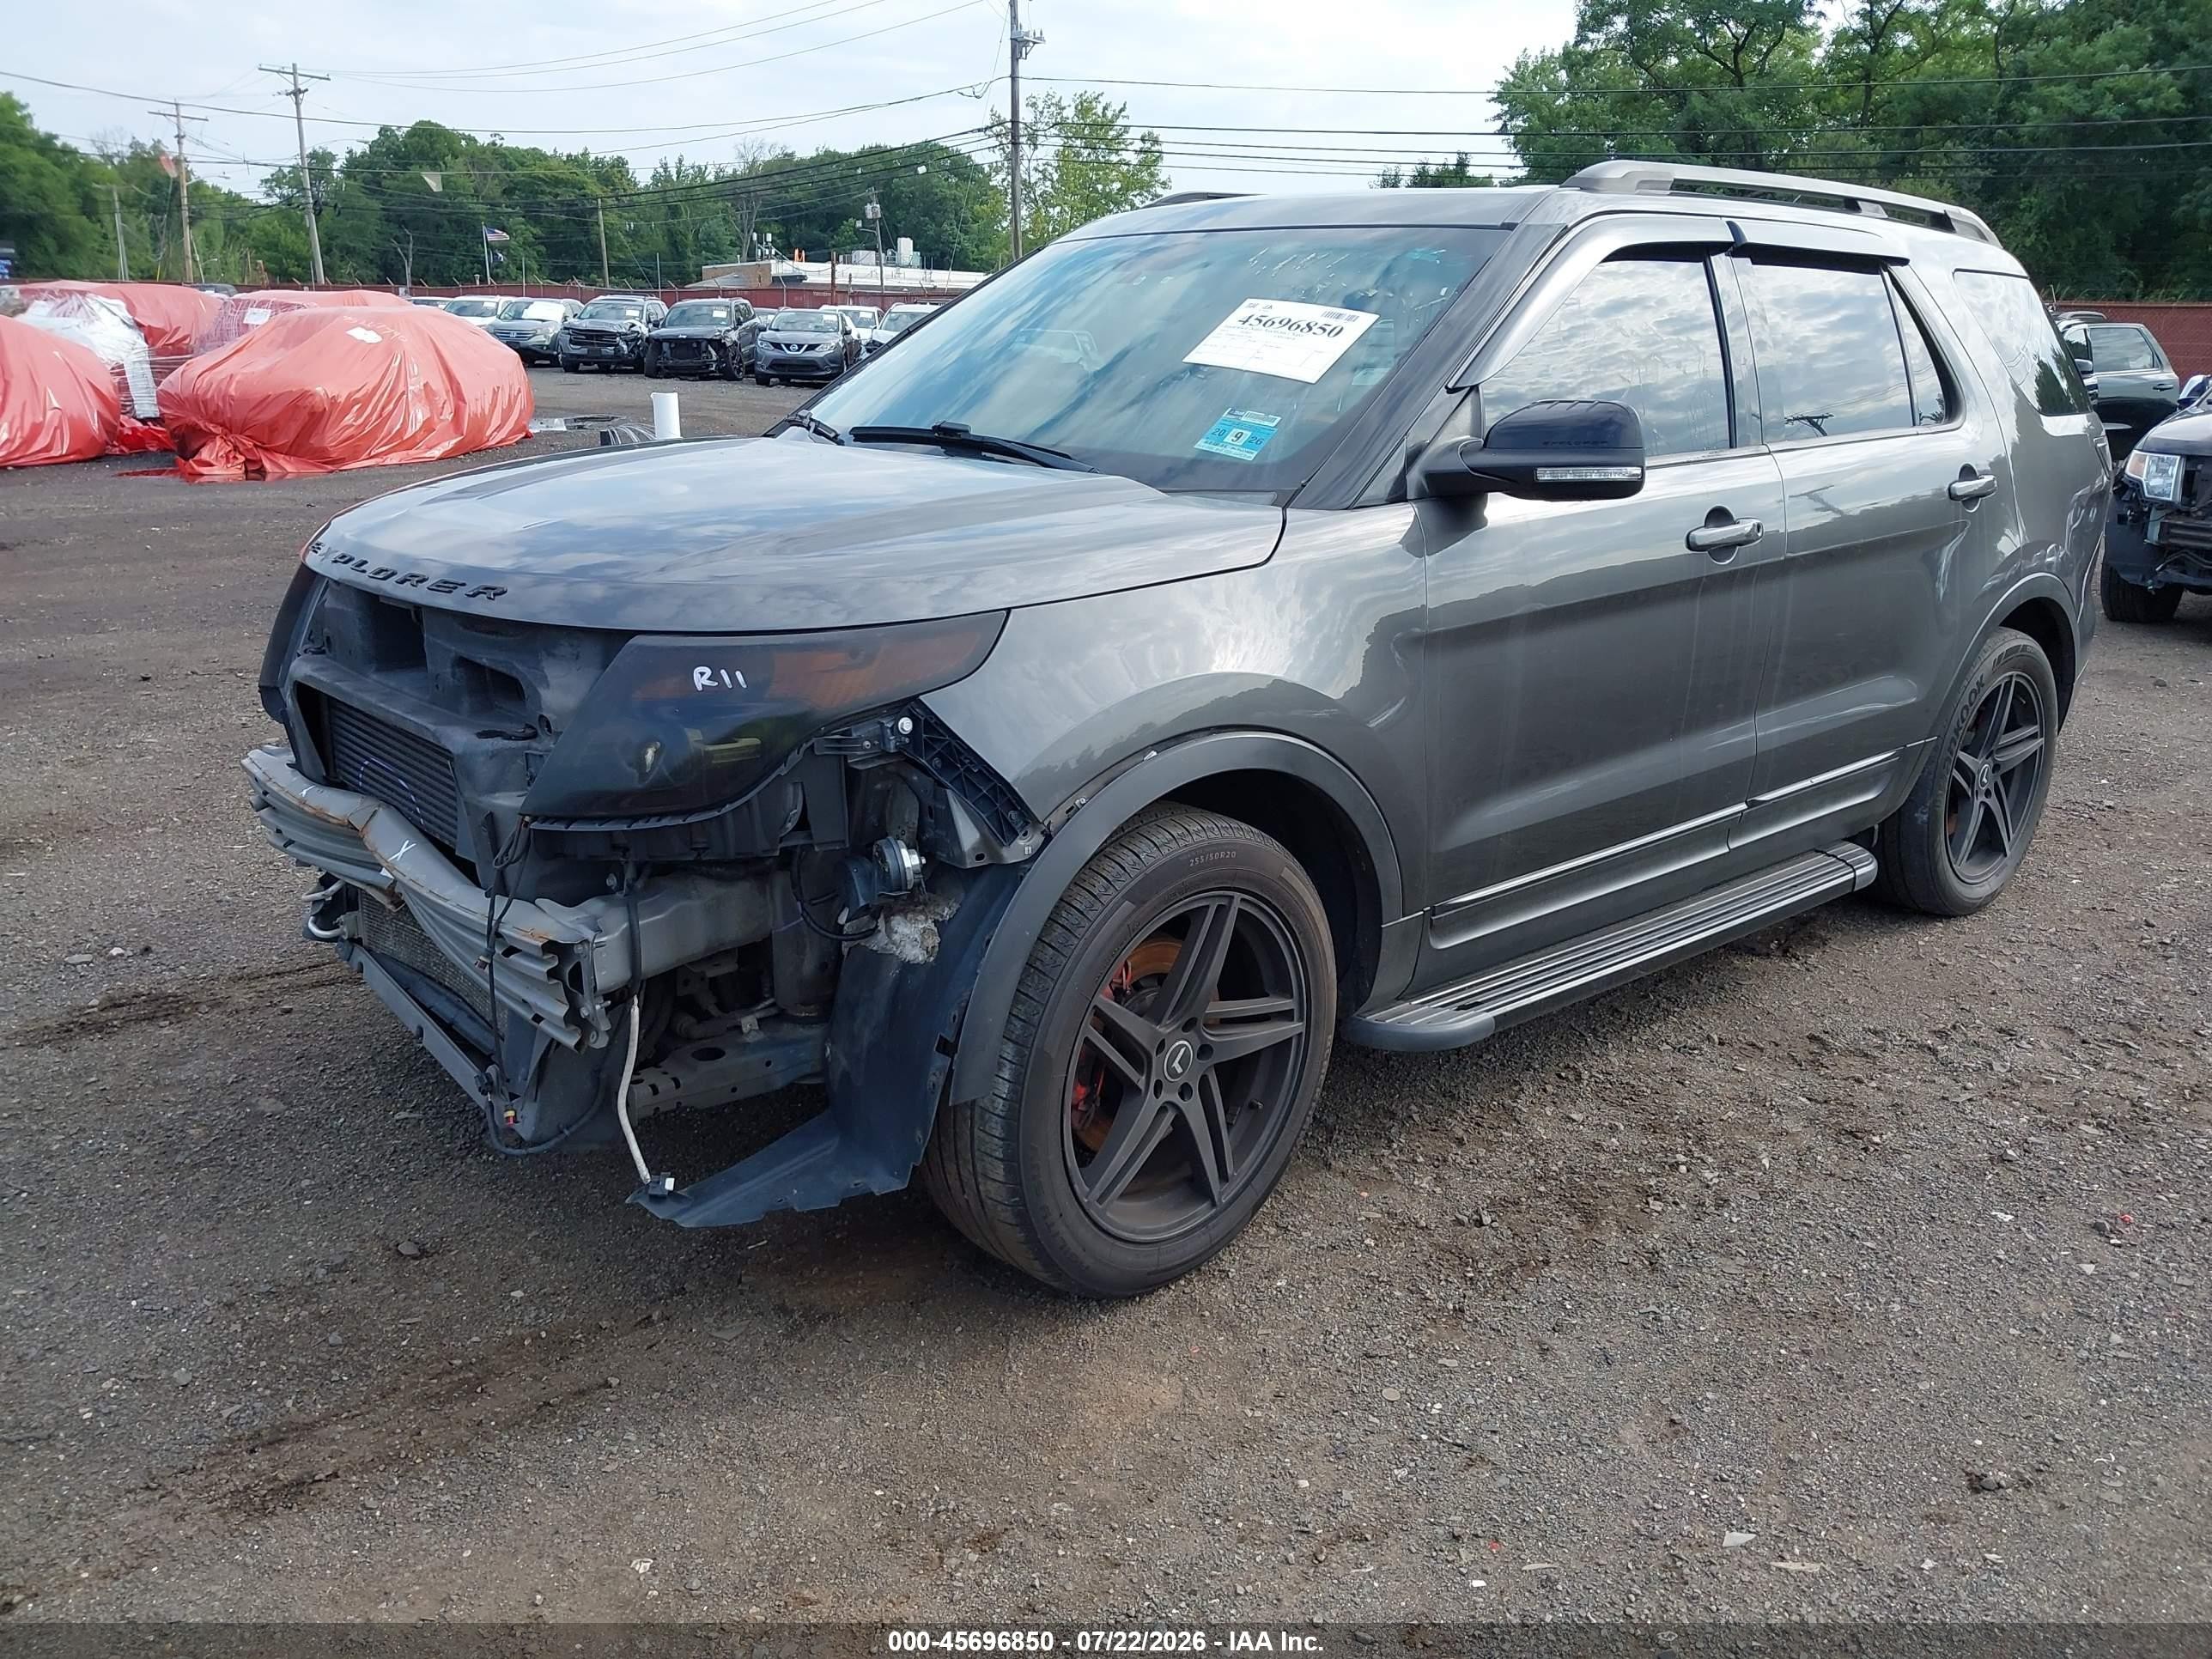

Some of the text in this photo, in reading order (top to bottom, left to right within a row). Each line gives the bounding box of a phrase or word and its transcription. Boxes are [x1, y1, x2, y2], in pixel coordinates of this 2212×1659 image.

[1237, 313, 1345, 338] 45696850
[1212, 428, 1265, 446] 20 9 26
